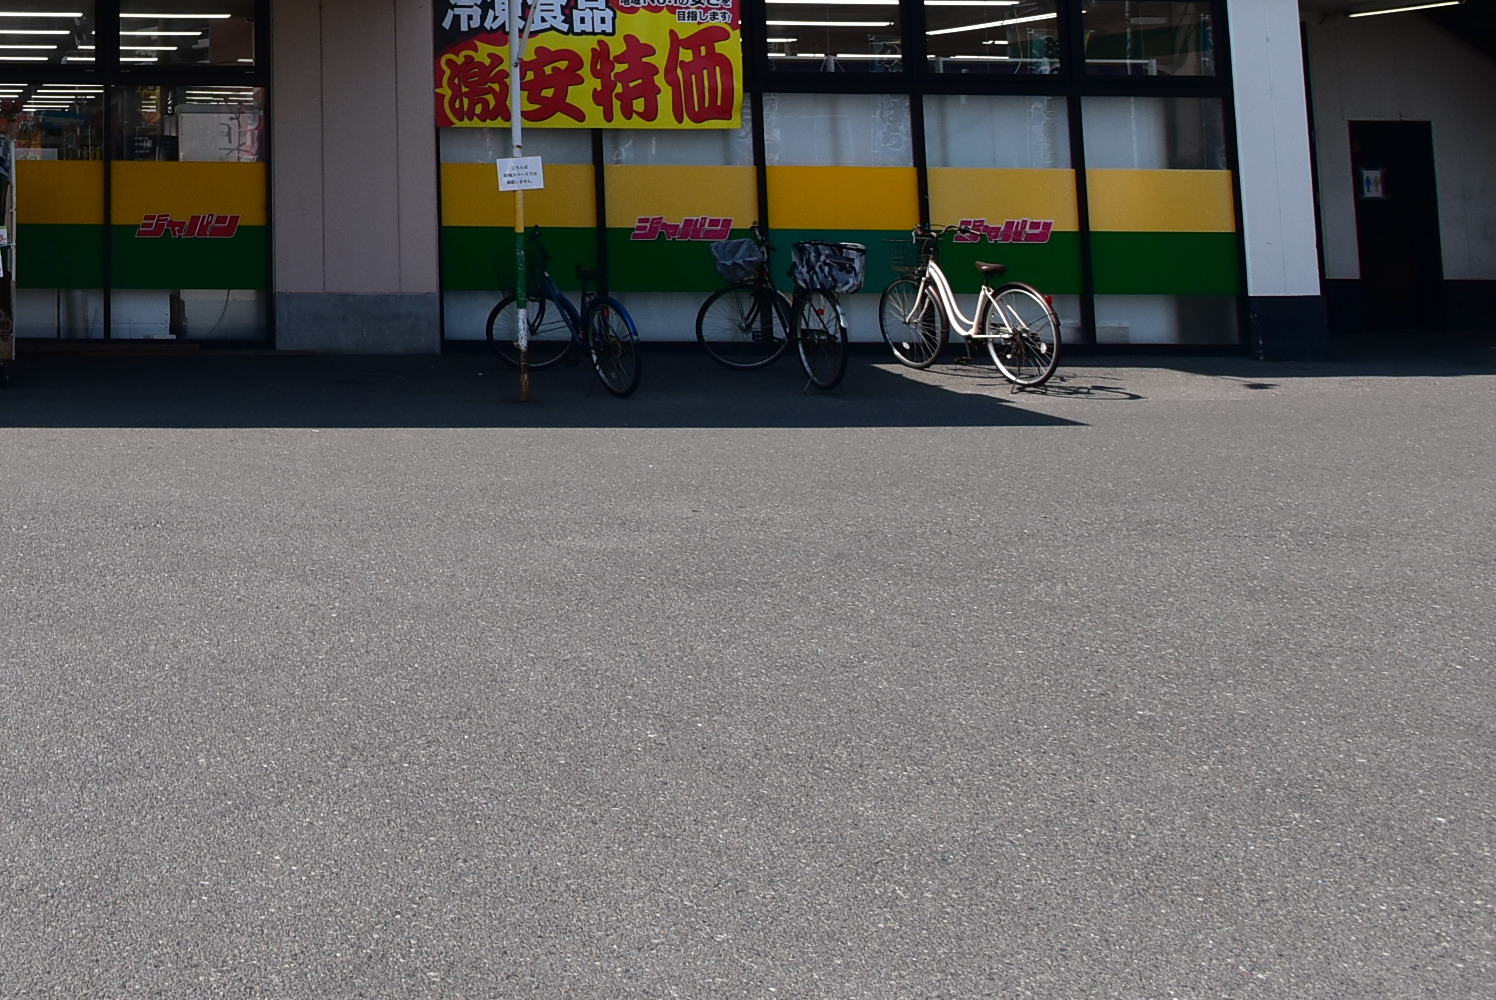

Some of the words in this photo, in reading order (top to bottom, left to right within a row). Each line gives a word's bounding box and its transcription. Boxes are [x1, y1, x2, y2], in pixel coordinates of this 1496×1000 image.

[444, 26, 735, 125] 激安特価
[135, 213, 241, 238] ジャパン
[630, 216, 734, 241] ジャパン
[953, 218, 1054, 244] ジャパン
